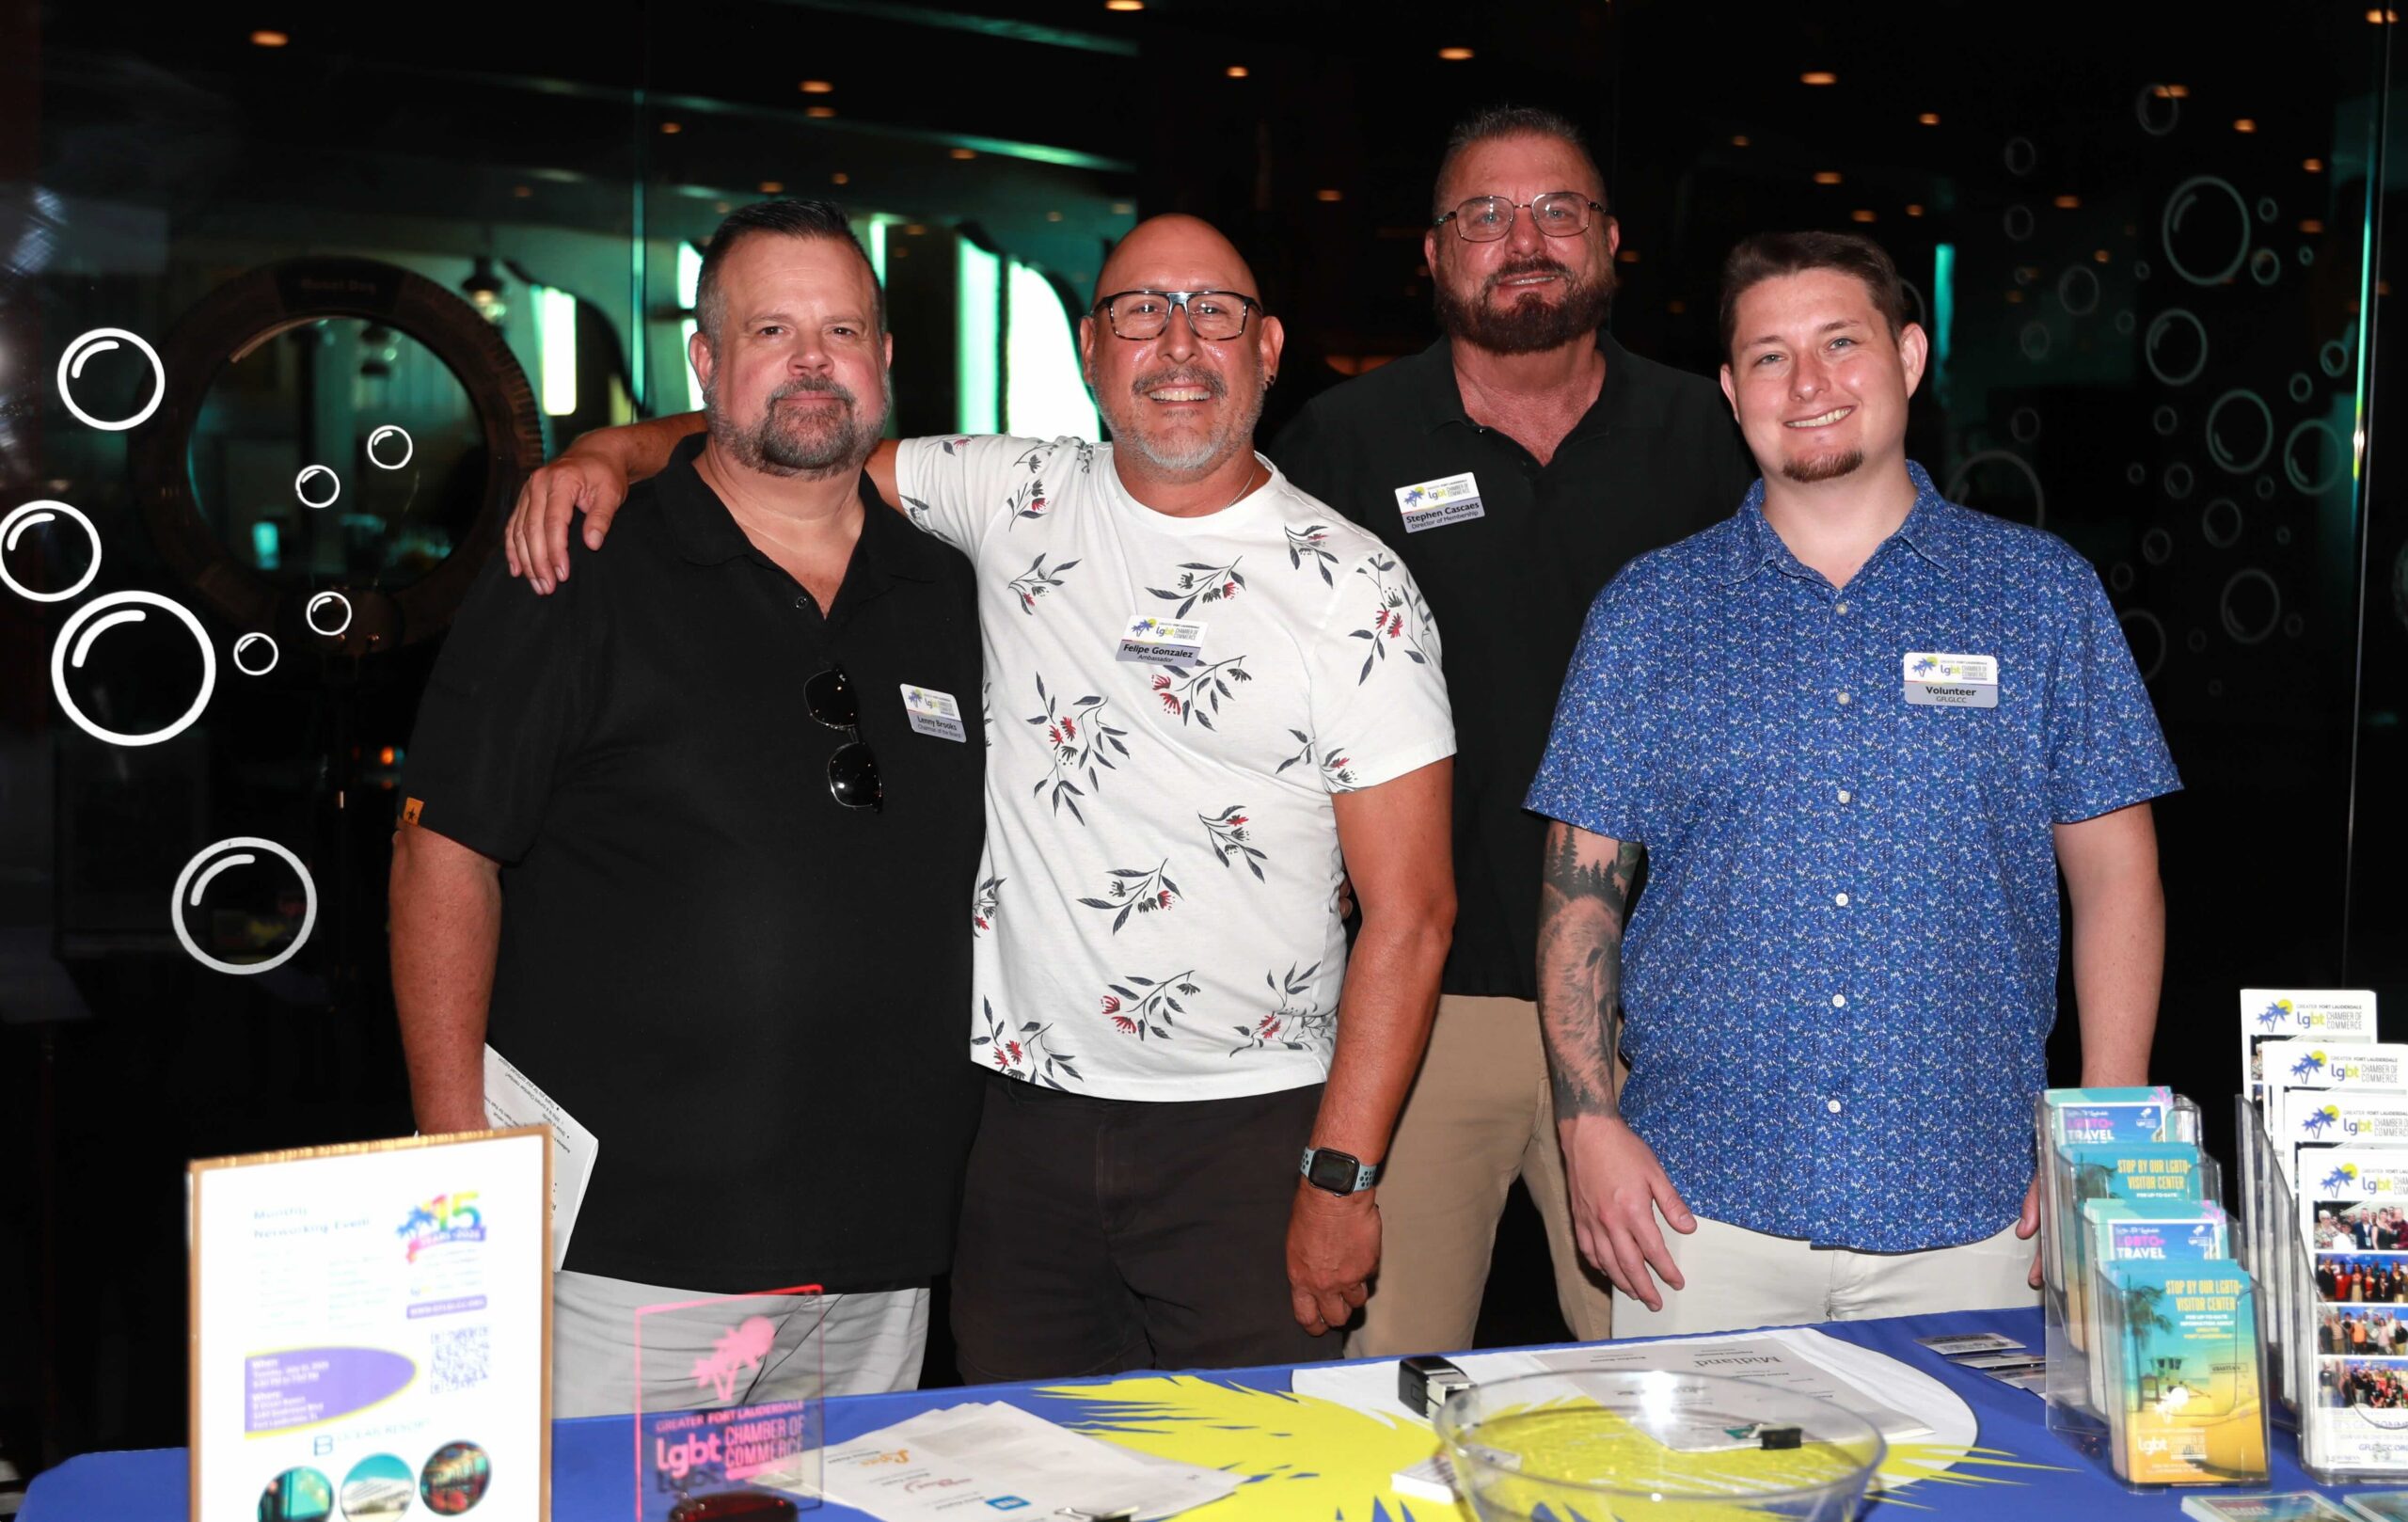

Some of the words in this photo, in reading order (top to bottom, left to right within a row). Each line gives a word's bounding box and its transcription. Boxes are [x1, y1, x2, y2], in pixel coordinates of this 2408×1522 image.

[1406, 510, 1443, 524] Stephen
[1445, 501, 1480, 515] Cascaes
[1411, 518, 1435, 529] Director
[1444, 511, 1479, 522] Membership
[1123, 643, 1149, 654] Felipe
[1152, 646, 1194, 658] Gonzalez
[1137, 654, 1173, 662] Ambassador
[1941, 664, 1961, 676] lgbt
[1925, 686, 1976, 696] Volunteer
[2297, 1011, 2325, 1029] lgbt
[2326, 1012, 2353, 1021] CHAMBER
[2355, 1012, 2362, 1021] OF
[2326, 1021, 2362, 1030] COMMERCE
[2331, 1063, 2359, 1081] lgbt
[2361, 1064, 2389, 1073] CHAMBER
[2391, 1064, 2398, 1073] OF
[2361, 1073, 2398, 1083] COMMERCE
[2343, 1118, 2372, 1135] lgbt
[2374, 1118, 2402, 1128] CHAMBER
[2067, 1130, 2115, 1140] TRAVEL
[2118, 1160, 2135, 1173] STOP
[2138, 1160, 2147, 1173] BY
[2149, 1160, 2164, 1173] OUR
[2128, 1177, 2156, 1189] VISITOR
[2158, 1177, 2184, 1189] CENTER
[2362, 1176, 2392, 1195] lgbt
[433, 1190, 483, 1230] 15
[2117, 1247, 2166, 1259] TRAVEL
[2165, 1280, 2184, 1293] STOP
[2187, 1280, 2196, 1293] BY
[2199, 1280, 2213, 1293] OUR
[2176, 1297, 2205, 1310] VISITOR
[2208, 1296, 2235, 1310] CENTER
[1694, 1356, 1783, 1369] Midland
[656, 1413, 705, 1432] GREATER
[707, 1409, 737, 1424] FORT
[737, 1400, 804, 1419] LAUDERDALE
[656, 1433, 723, 1479] lgbt
[724, 1418, 786, 1446] CHAMBER
[789, 1415, 805, 1435] OF
[724, 1437, 803, 1467] COMMERCE
